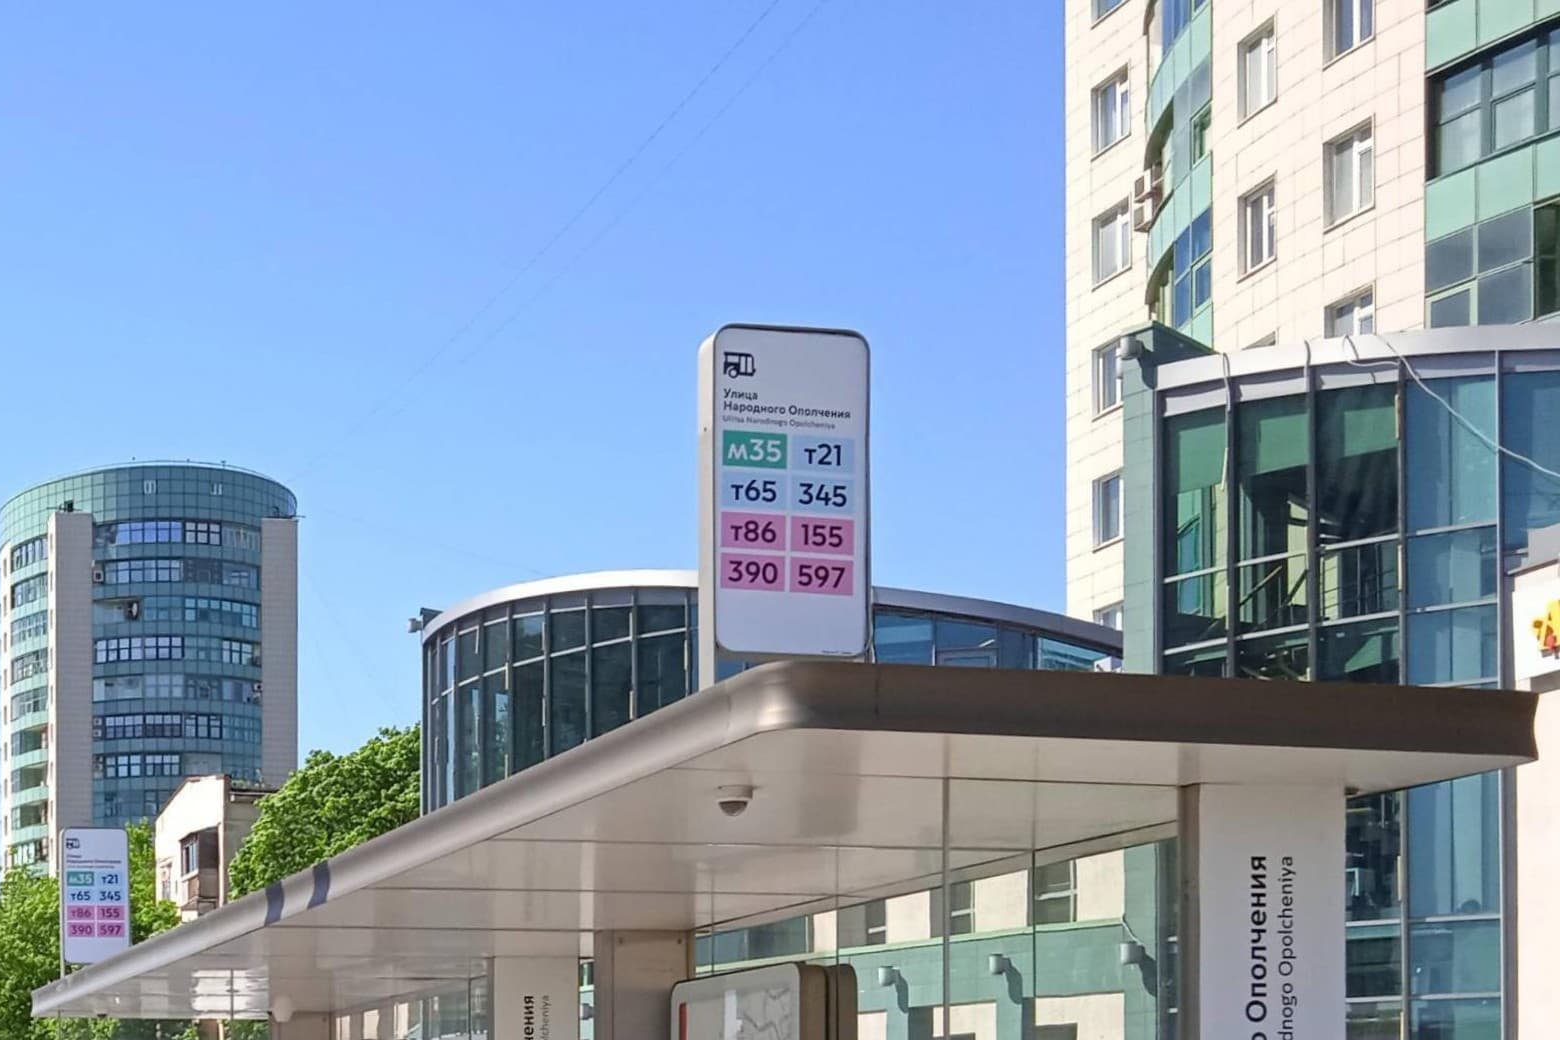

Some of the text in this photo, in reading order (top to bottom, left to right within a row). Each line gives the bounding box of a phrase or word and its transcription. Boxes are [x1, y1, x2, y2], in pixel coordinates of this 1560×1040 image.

[723, 388, 758, 400] Улица
[723, 400, 851, 419] Народного Ополчения
[727, 438, 782, 464] м35
[804, 444, 842, 466] т21
[730, 479, 777, 503] т65
[798, 483, 847, 507] 345
[730, 520, 777, 543] т86
[801, 524, 843, 548] 155
[728, 560, 779, 584] 390
[797, 565, 846, 589] 597
[99, 891, 121, 901] 345
[101, 908, 120, 918] 155
[1278, 855, 1296, 978] Opolcheniya
[100, 925, 121, 935] 597
[1247, 855, 1268, 1022] Ополчения
